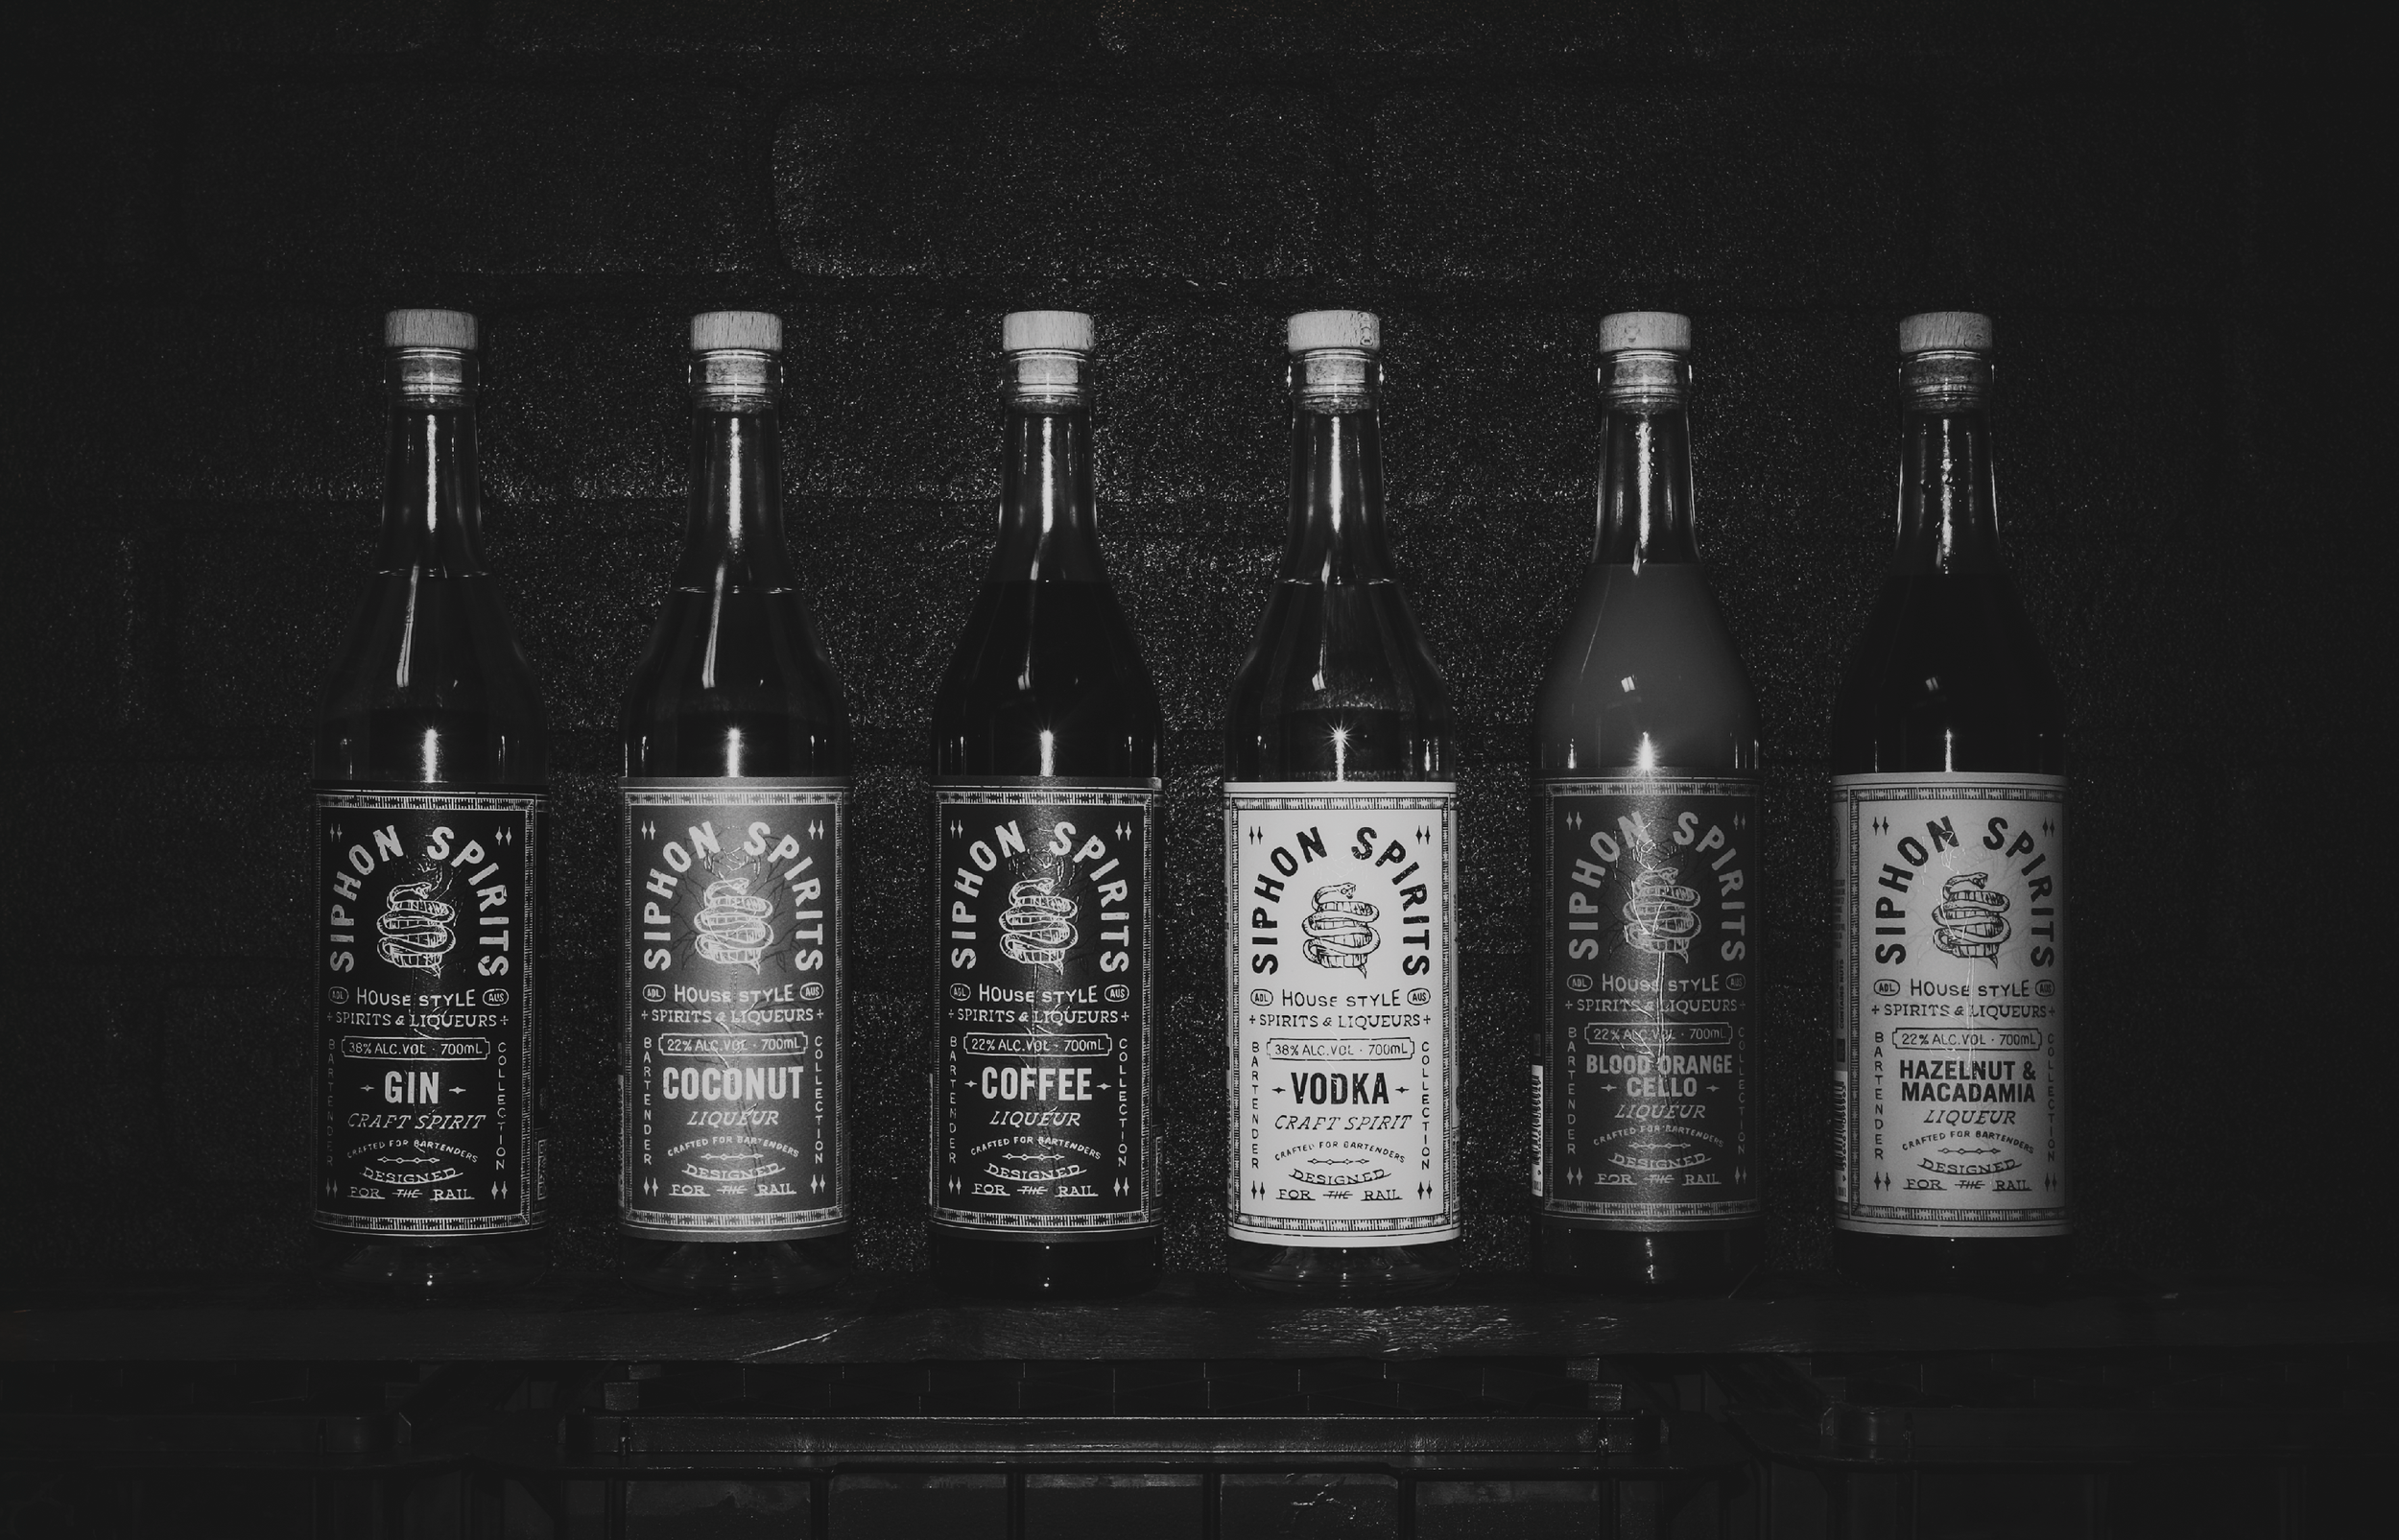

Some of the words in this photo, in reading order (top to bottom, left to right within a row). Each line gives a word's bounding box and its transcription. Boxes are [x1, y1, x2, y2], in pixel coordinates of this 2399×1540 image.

[951, 820, 1026, 970] SIPHON
[1569, 812, 1651, 960] SIPHON
[1673, 812, 1746, 961] SPIRITS
[1875, 816, 1960, 964] SIPHON
[1983, 817, 2055, 967] SPIRITS
[330, 825, 403, 973] SIPHON
[427, 827, 509, 976] SPIRITS
[644, 821, 720, 971] SIPHON
[744, 821, 823, 971] SPIRITS
[1050, 821, 1129, 972] SPIRITS
[1252, 826, 1327, 975] SIPHON
[1351, 827, 1430, 976] SPIRITS
[805, 986, 819, 996] AUS
[1572, 979, 1587, 988] ADL
[1668, 974, 1720, 991] STYLE
[1879, 983, 1894, 992] ADL
[1911, 979, 1969, 997] HOUSE
[1979, 980, 2030, 997] STYLE
[357, 987, 411, 1006] HOUSE
[419, 989, 475, 1007] STYLE
[488, 992, 504, 1002] AUS
[648, 988, 660, 998] ADL
[675, 984, 731, 1003] HOUSE
[739, 983, 794, 1003] STYLE
[980, 983, 1034, 1003] HOUSE
[1042, 985, 1098, 1003] STYLE
[1110, 989, 1125, 998] AUS
[1255, 993, 1268, 1003] ADL
[1283, 989, 1338, 1007] HOUSE
[1346, 989, 1400, 1007] STYLE
[1413, 992, 1427, 1002] AUS
[1578, 1001, 1638, 1011] SPIRITS
[1641, 1002, 1653, 1011] &
[1660, 999, 1737, 1014] LIQUEURS
[1885, 1004, 1950, 1016] SPIRITS
[1955, 1007, 1964, 1016] &
[1969, 1005, 2046, 1020] LIQUEURS
[336, 1012, 391, 1026] SPIRITS
[395, 1015, 405, 1025] &
[410, 1015, 496, 1030] LIQUEURS
[652, 1010, 711, 1023] SPIRITS
[716, 1012, 725, 1022] &
[731, 1008, 813, 1026] LIQUEURS
[958, 1008, 1015, 1022] SPIRITS
[1019, 1011, 1029, 1022] &
[1033, 1010, 1118, 1026] LIQUEURS
[1260, 1015, 1318, 1028] SPIRITS
[1322, 1017, 1332, 1027] &
[1338, 1014, 1420, 1030] LIQUEURS
[1594, 1029, 1620, 1040] 22%
[1689, 1029, 1726, 1039] 700mL
[1902, 1033, 1929, 1045] 22%
[2000, 1033, 2035, 1045] 700mL
[349, 1042, 371, 1053] 38%
[440, 1044, 482, 1054] 700mL
[668, 1039, 692, 1051] 22%
[762, 1038, 800, 1051] 700mL
[971, 1039, 996, 1051] 22%
[1064, 1040, 1104, 1051] 700mL
[1275, 1044, 1298, 1055] 38%
[1368, 1042, 1408, 1055] 700mL
[1586, 1054, 1650, 1074] BLOOD
[1659, 1054, 1732, 1074] ORANGE
[1900, 1060, 2015, 1080] HAZELNUT
[2023, 1061, 2035, 1080] &
[385, 1071, 439, 1103] GIN
[663, 1066, 803, 1101] COCONUT
[982, 1067, 1092, 1101] COFFEE
[1291, 1073, 1390, 1104] VODKA
[1567, 1028, 1577, 1154] BARTENDER
[1627, 1078, 1698, 1097] CELLO
[1902, 1082, 2035, 1102] MACADAMIA
[815, 1035, 823, 1164] COLLECTION
[949, 1036, 958, 1164] BARTENDER
[1118, 1038, 1128, 1167] COLLECTION
[1874, 1031, 1884, 1160] BARTENDER
[495, 1041, 507, 1171] COLLECTION
[1251, 1041, 1260, 1170] BARTENDER
[1421, 1041, 1430, 1171] COLLECTION
[1615, 1105, 1705, 1121] LIQUEUR
[348, 1113, 411, 1129] CRAFT
[415, 1115, 486, 1129] SPIRIT
[687, 1111, 779, 1127] LIQUEUR
[989, 1111, 1081, 1127] LIQUEUR
[1275, 1115, 1341, 1130] CRAFT
[1344, 1115, 1413, 1130] SPIRIT
[1923, 1110, 2016, 1125] LIQUEUR
[1594, 1127, 1635, 1146] CRAFTED
[1666, 1125, 1723, 1148] BARTENDERS
[1902, 1133, 1946, 1150] CRAFTED
[1976, 1130, 2033, 1153] BARTENDERS
[347, 1141, 385, 1158] CRAFTED
[415, 1140, 478, 1163] BARTENDERS
[668, 1139, 708, 1156] CRAFTED
[713, 1136, 733, 1145] FOR
[737, 1135, 799, 1158] BARTENDERS
[971, 1138, 1009, 1155] CRAFTED
[1013, 1136, 1033, 1145] FOR
[1037, 1136, 1101, 1160] BARTENDERS
[1343, 1141, 1406, 1163] BARTENDERS
[1613, 1153, 1705, 1169] DESIGNED
[1922, 1158, 2015, 1174] DESIGNED
[363, 1167, 457, 1182] DESIGNED
[686, 1163, 779, 1179] DESIGNED
[987, 1163, 1081, 1179] DESIGNED
[1293, 1169, 1386, 1185] DESIGNED
[1598, 1173, 1631, 1183] FOR
[1649, 1174, 1672, 1184] THE
[1685, 1174, 1719, 1184] RAIL
[350, 1187, 380, 1197] FOR
[396, 1189, 420, 1197] THE
[434, 1189, 471, 1199] RAIL
[673, 1184, 704, 1195] FOR
[722, 1185, 746, 1195] THE
[757, 1183, 794, 1195] RAIL
[974, 1184, 1006, 1194] FOR
[1022, 1186, 1044, 1195] THE
[1058, 1185, 1095, 1196] RAIL
[1907, 1179, 1940, 1190] FOR
[1960, 1180, 1983, 1189] THE
[1996, 1180, 2030, 1190] RAIL
[1279, 1190, 1310, 1200] FOR
[1328, 1191, 1349, 1199] THE
[1365, 1190, 1400, 1200] RAIL
